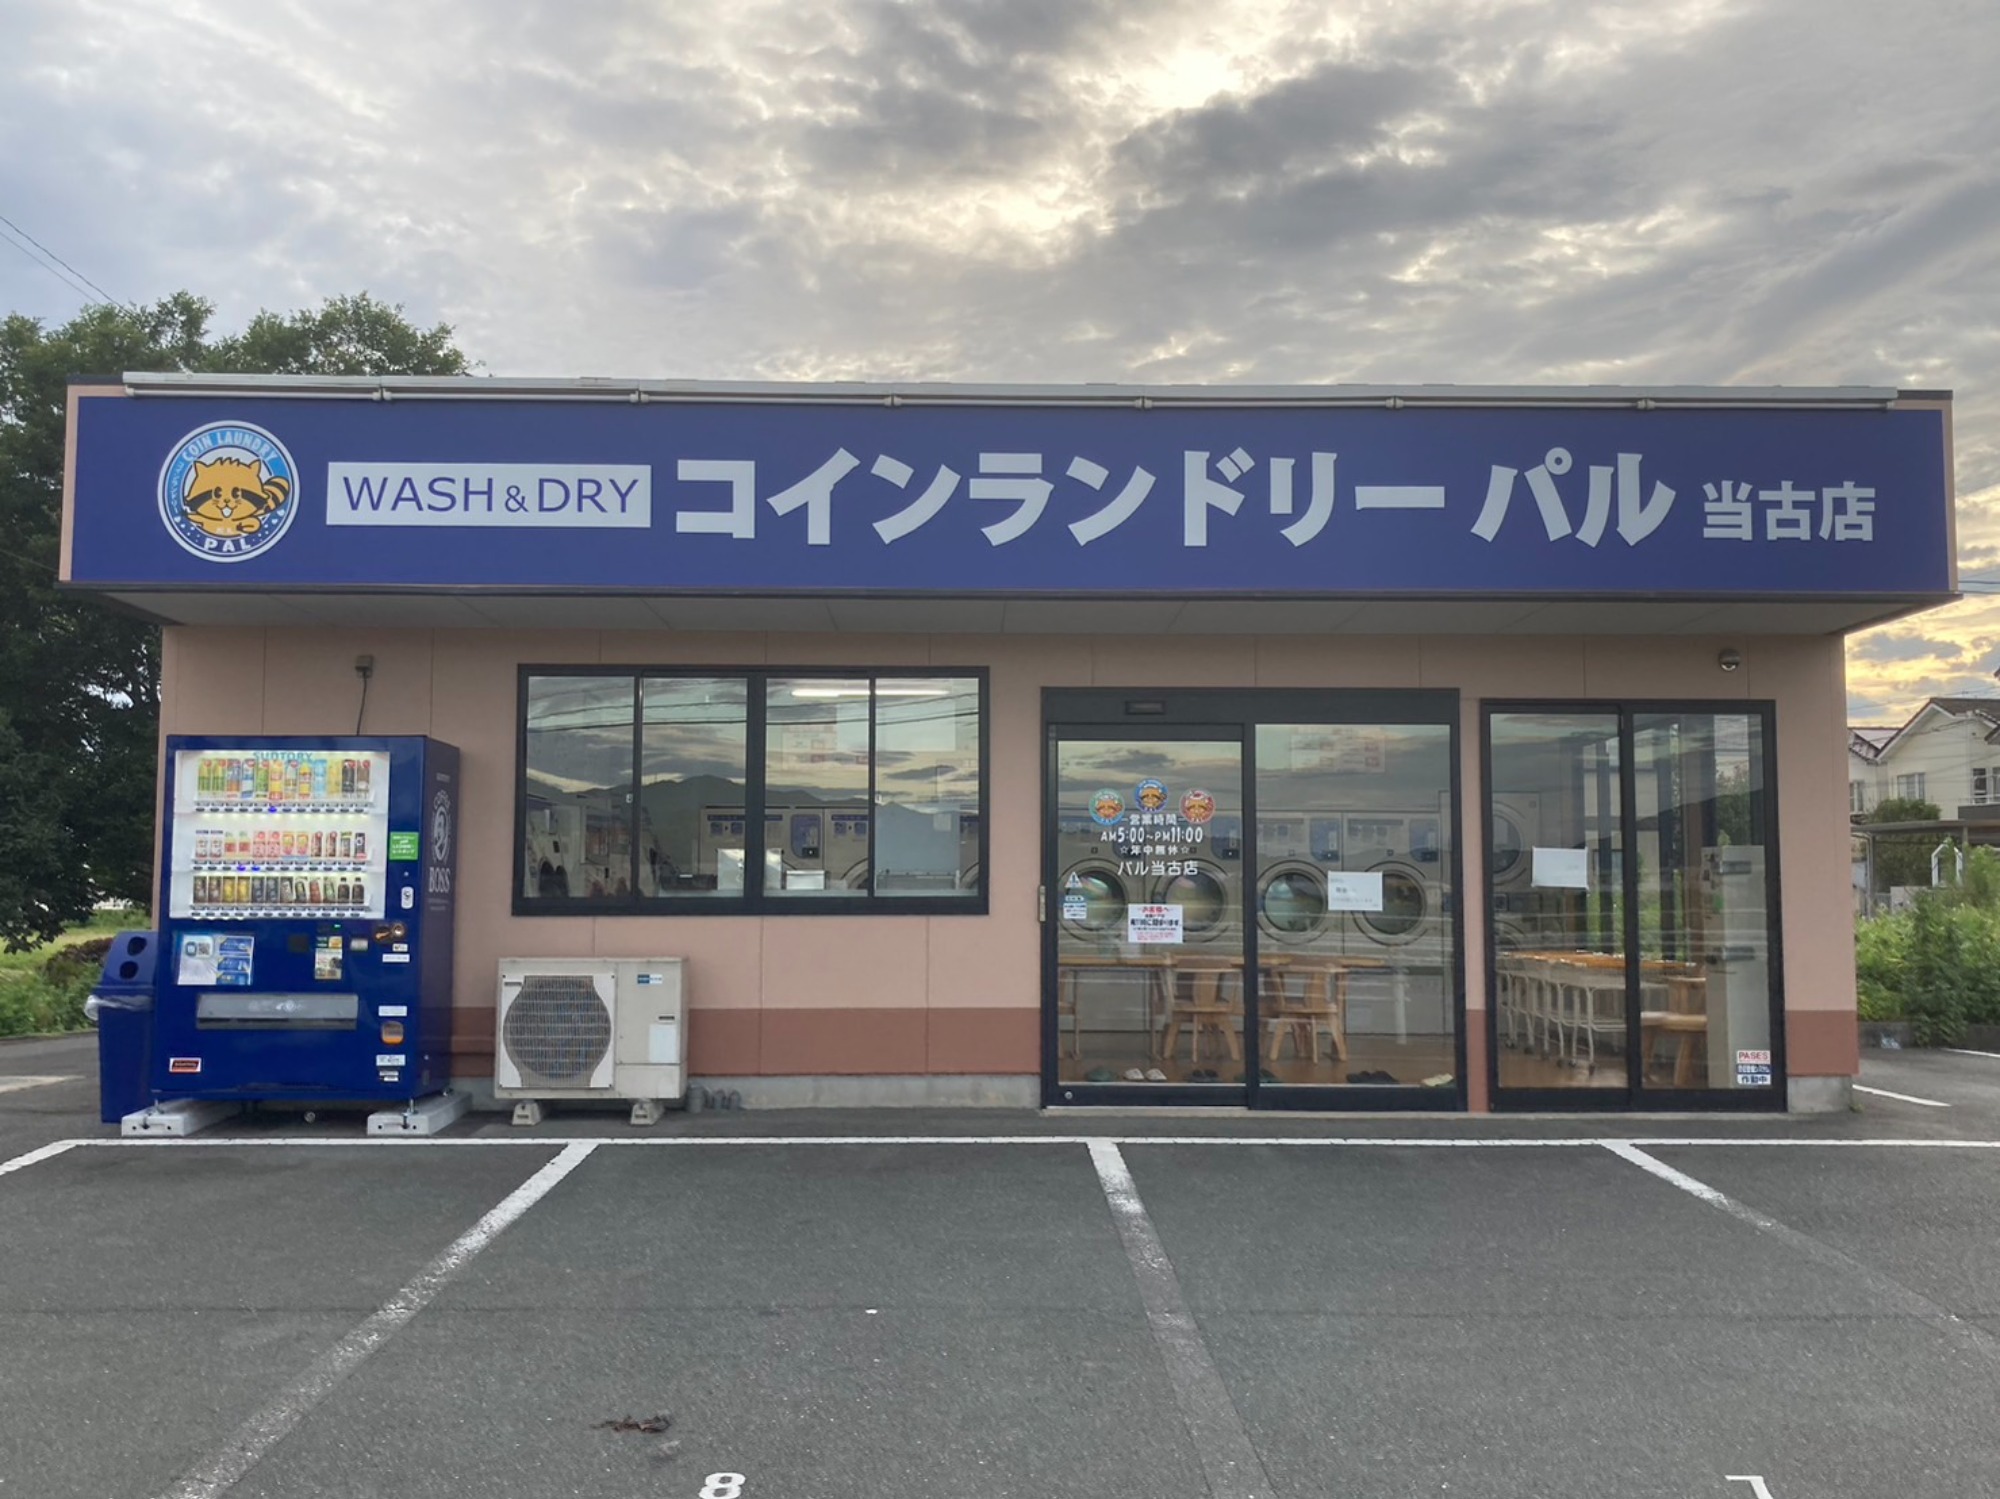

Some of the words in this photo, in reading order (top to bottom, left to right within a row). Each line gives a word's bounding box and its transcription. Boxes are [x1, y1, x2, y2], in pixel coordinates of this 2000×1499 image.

[182, 434, 214, 463] COIN
[216, 431, 278, 465] LAUNDRY
[342, 475, 639, 514] WASH&DRY
[676, 446, 1446, 548] コインランドリー
[1470, 446, 1677, 549] パル
[1702, 480, 1877, 542] 当古店
[203, 537, 253, 553] PAL
[1129, 813, 1177, 826] 営業時間
[428, 866, 451, 893] BOSS
[1738, 1051, 1768, 1060] PASES
[698, 1472, 746, 1499] 8
